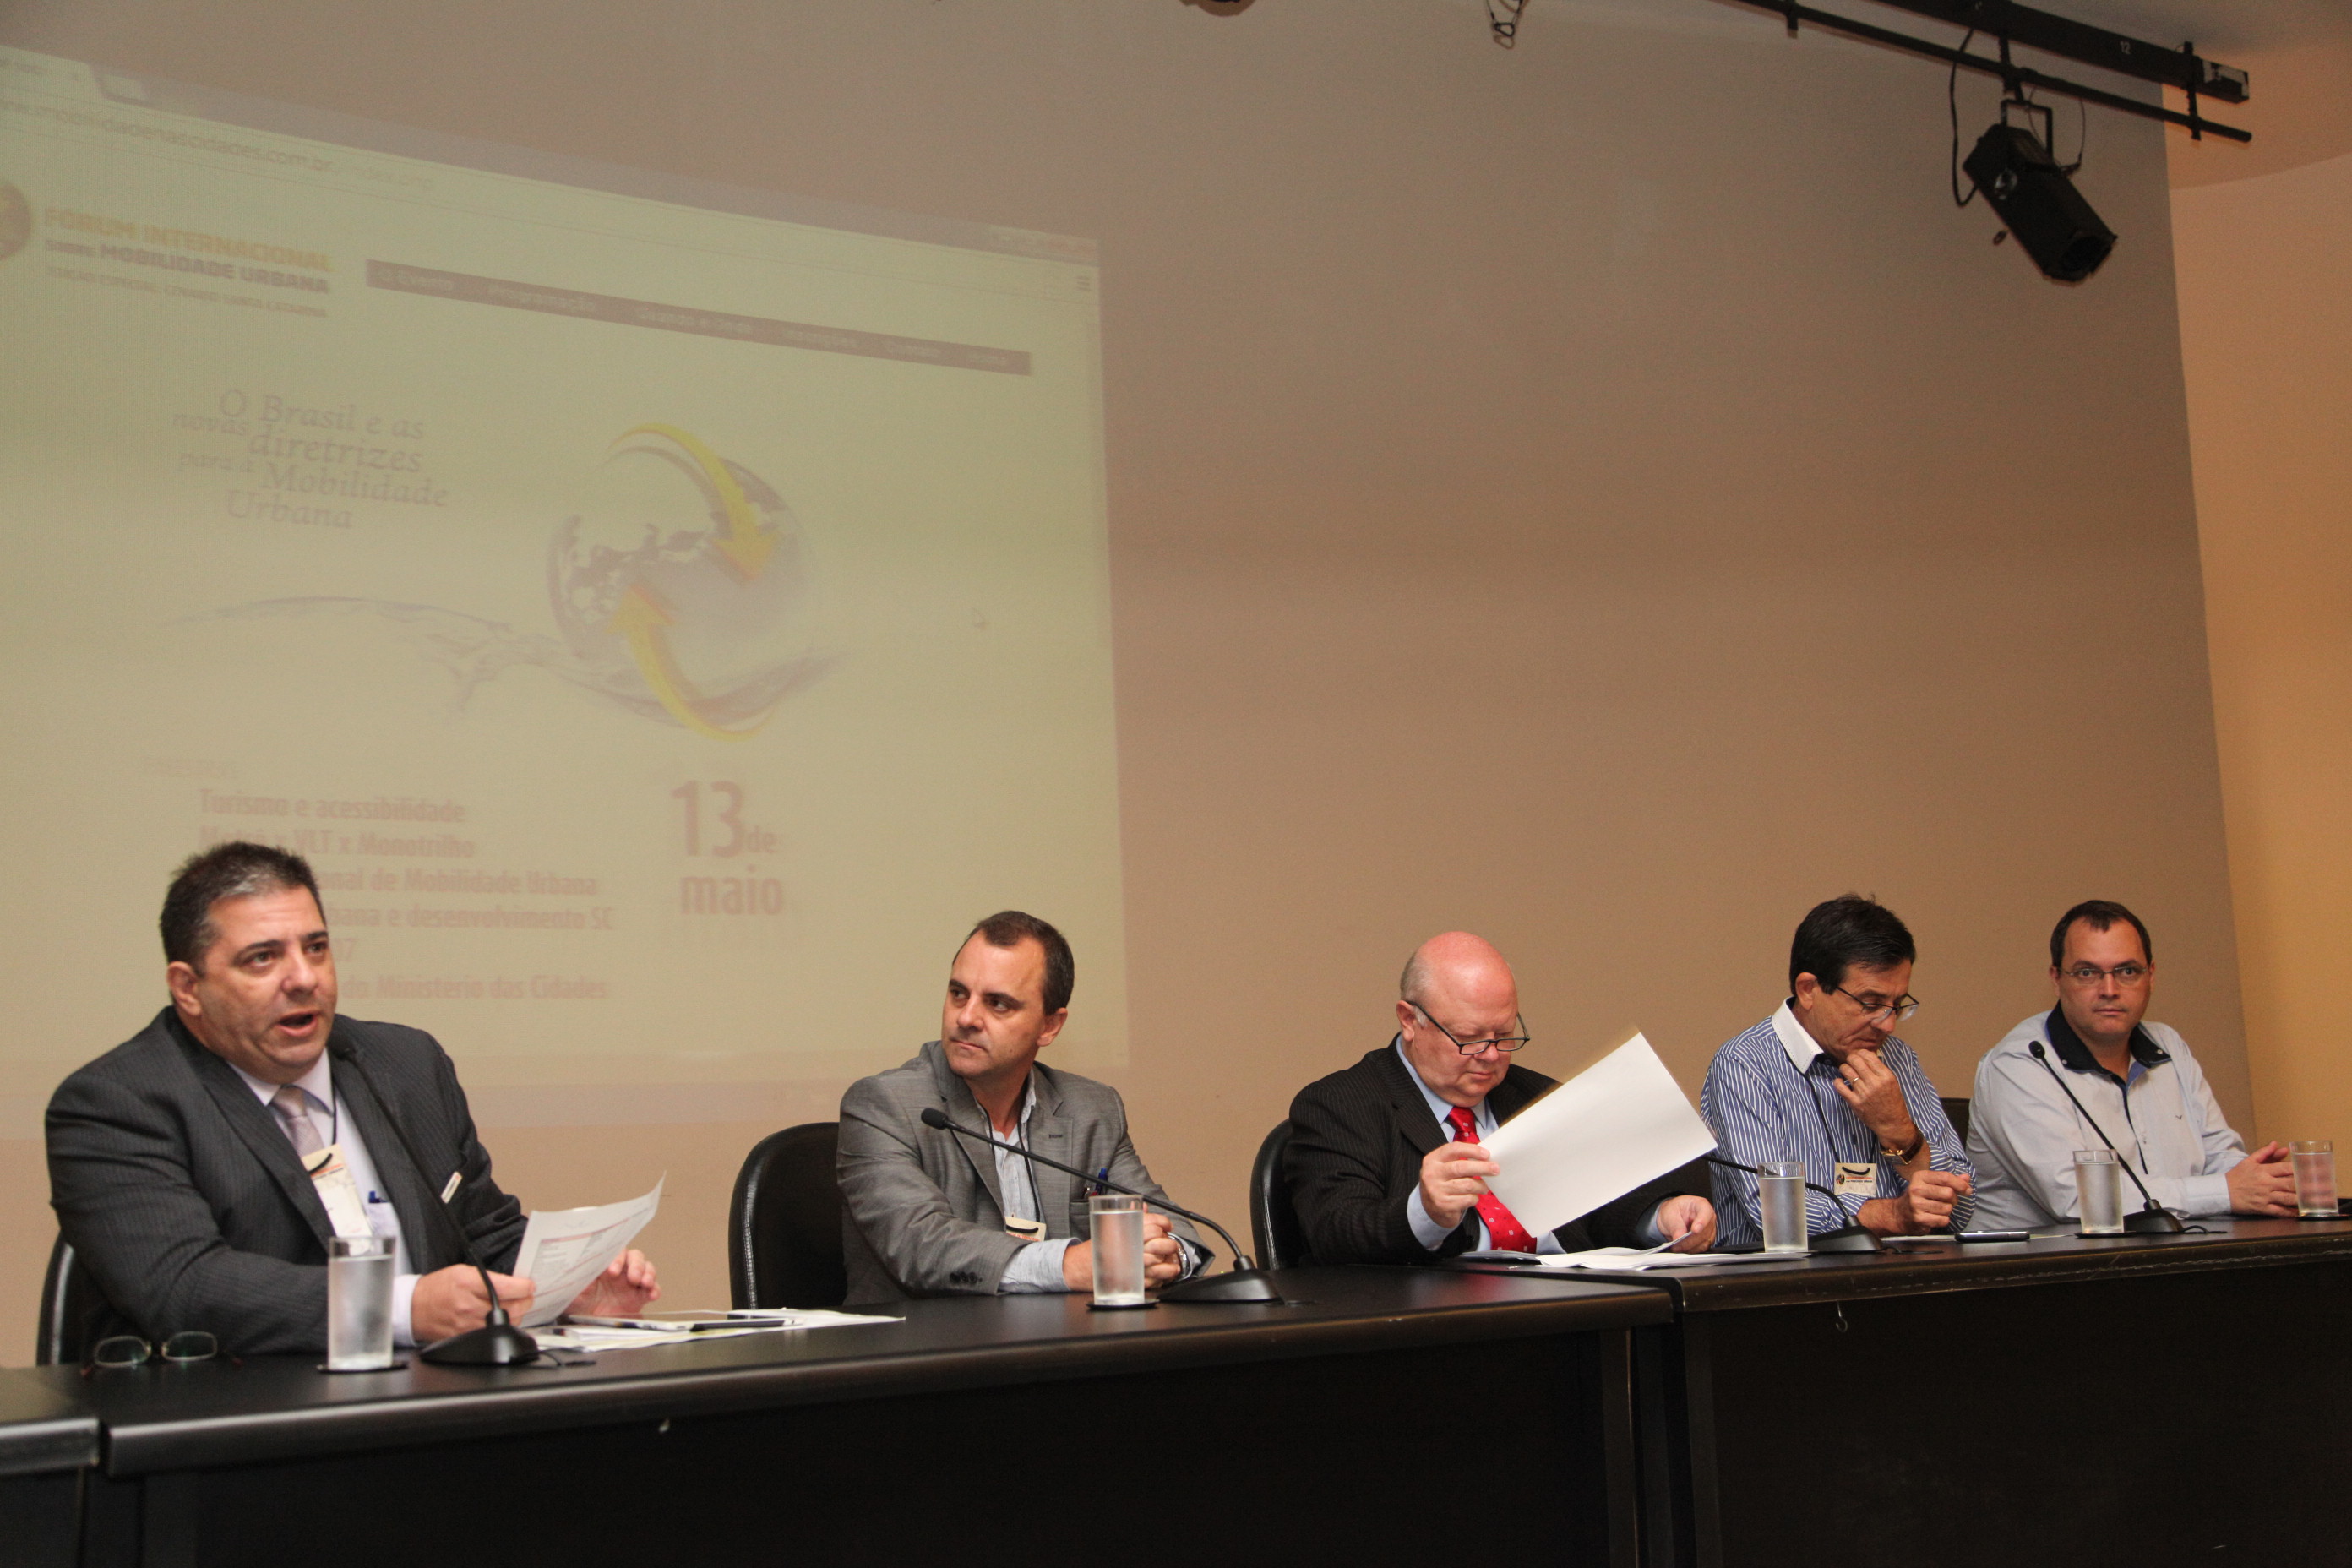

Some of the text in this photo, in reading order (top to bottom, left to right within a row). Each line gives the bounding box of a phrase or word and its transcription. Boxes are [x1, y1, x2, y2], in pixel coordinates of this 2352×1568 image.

[100, 243, 235, 280] MOBILIDADE
[240, 266, 331, 294] URBANA
[142, 223, 333, 272] INTERNACIONAL
[398, 270, 455, 291] Evento
[219, 388, 426, 440] O Brasil e as
[170, 411, 425, 473] novas diretrizes
[177, 452, 451, 508] para a Mobilidade
[226, 488, 354, 530] Urbana
[199, 787, 467, 824] Turismo e acessibilidade
[671, 780, 778, 859] 13 de
[293, 827, 334, 855] VLT
[337, 835, 352, 855] x
[358, 830, 476, 860] Monotrilho
[369, 868, 398, 891] de
[403, 868, 521, 896] Mobilidade
[526, 870, 599, 896] Urbana
[679, 863, 785, 917] maio
[328, 903, 614, 930] bana e desenvolvimento SC
[375, 974, 484, 999] Ministério
[489, 976, 525, 999] das
[530, 973, 608, 999] Cidades
